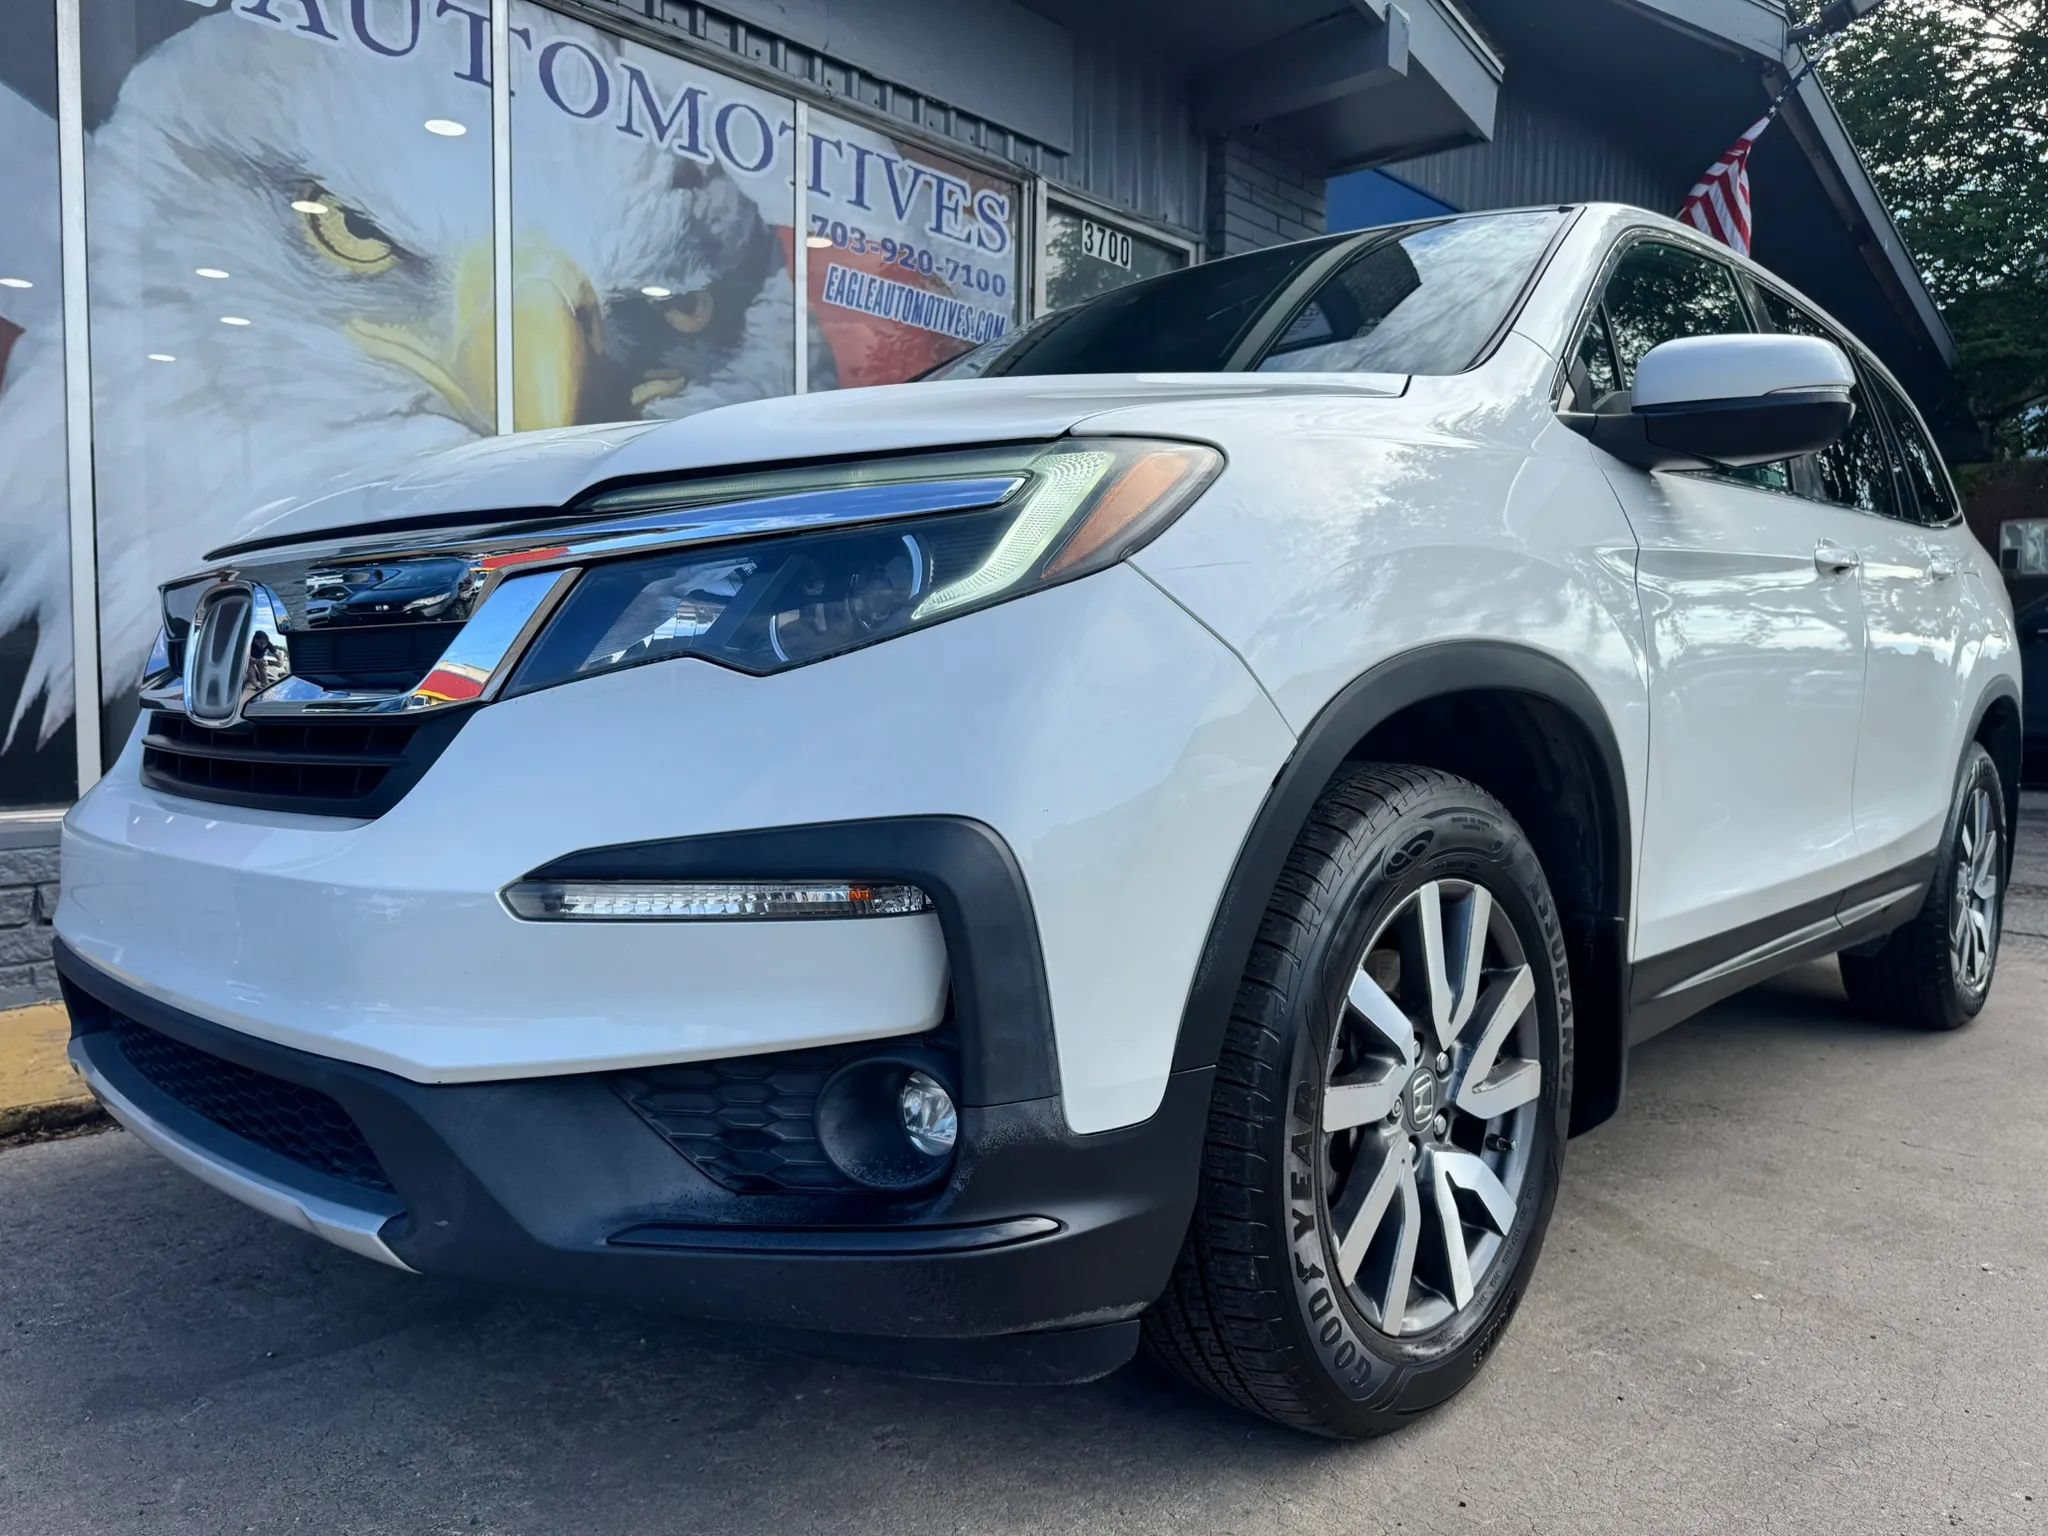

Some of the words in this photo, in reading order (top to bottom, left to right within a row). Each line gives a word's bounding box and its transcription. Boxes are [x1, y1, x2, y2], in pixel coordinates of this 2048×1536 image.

[811, 214, 1006, 297] 703-920-7100
[1084, 222, 1129, 267] 3700
[825, 265, 1006, 343] EAGLEAUTOMOTIVES.COM
